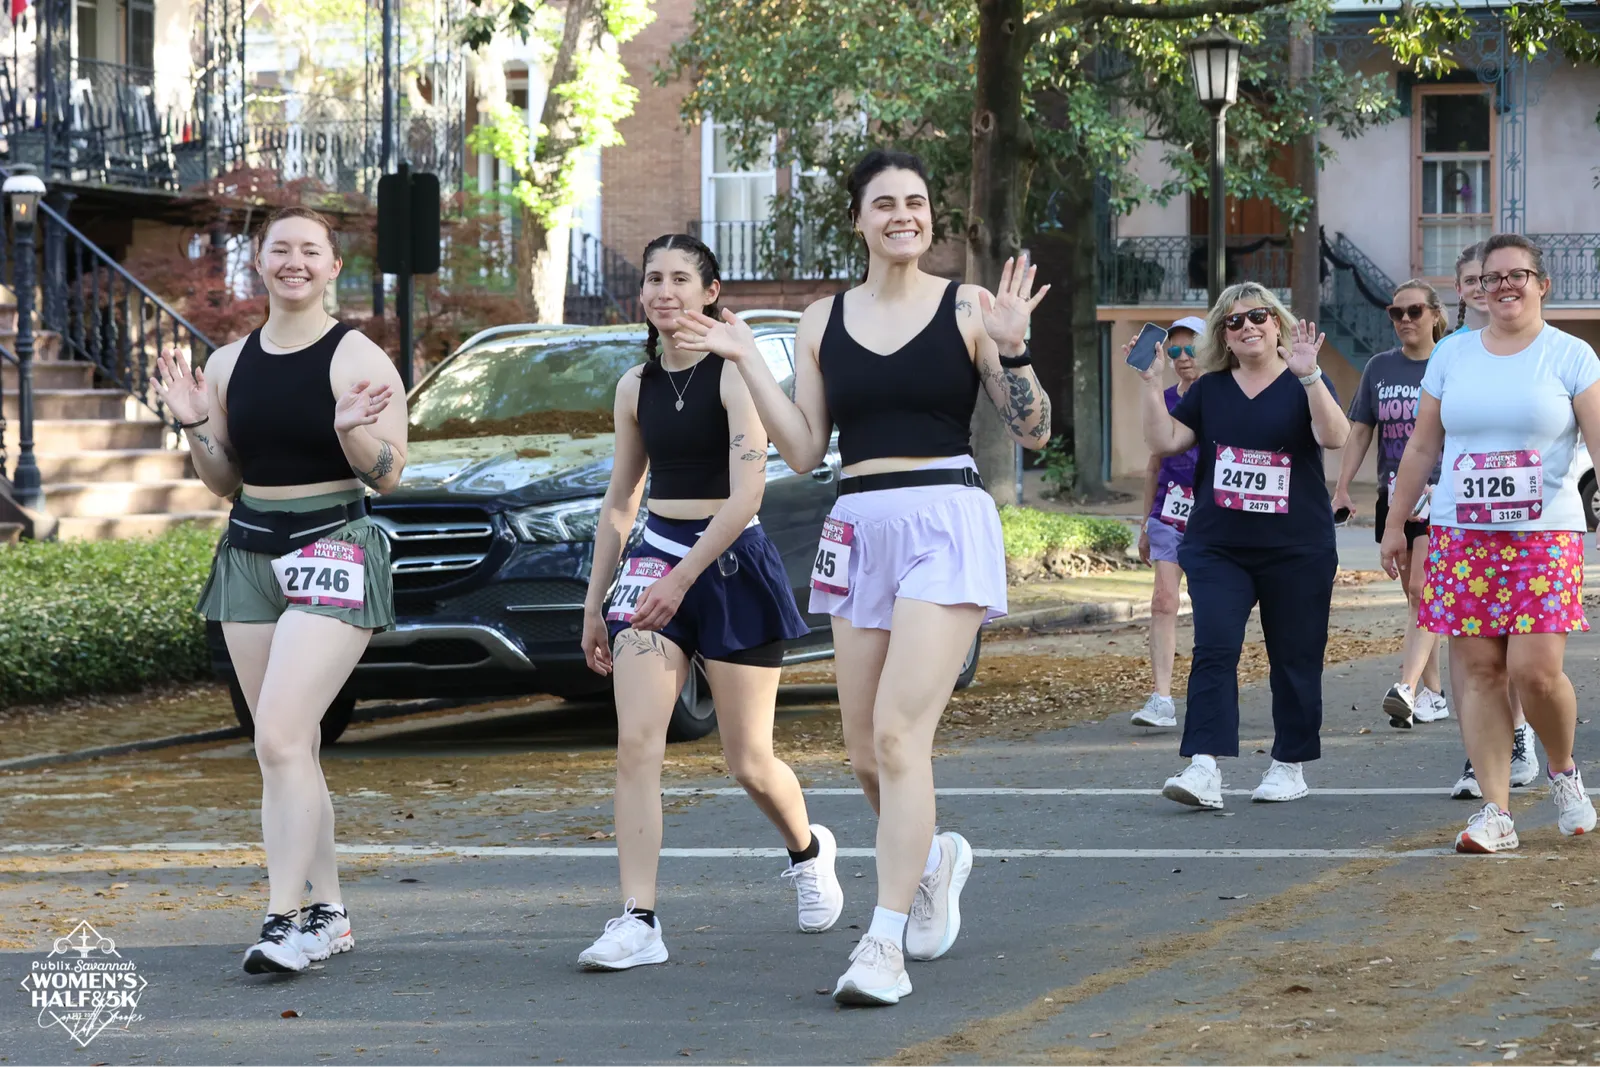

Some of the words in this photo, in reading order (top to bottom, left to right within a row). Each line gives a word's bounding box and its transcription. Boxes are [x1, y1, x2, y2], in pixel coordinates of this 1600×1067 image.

[1222, 468, 1267, 491] 2479
[1463, 476, 1515, 498] 3126
[1529, 475, 1537, 494] 3126
[1249, 501, 1269, 511] 2479
[1499, 510, 1522, 520] 3126
[314, 542, 354, 555] WOMEN'S
[815, 549, 836, 578] 45
[284, 567, 349, 592] 2746
[611, 584, 647, 608] 274
